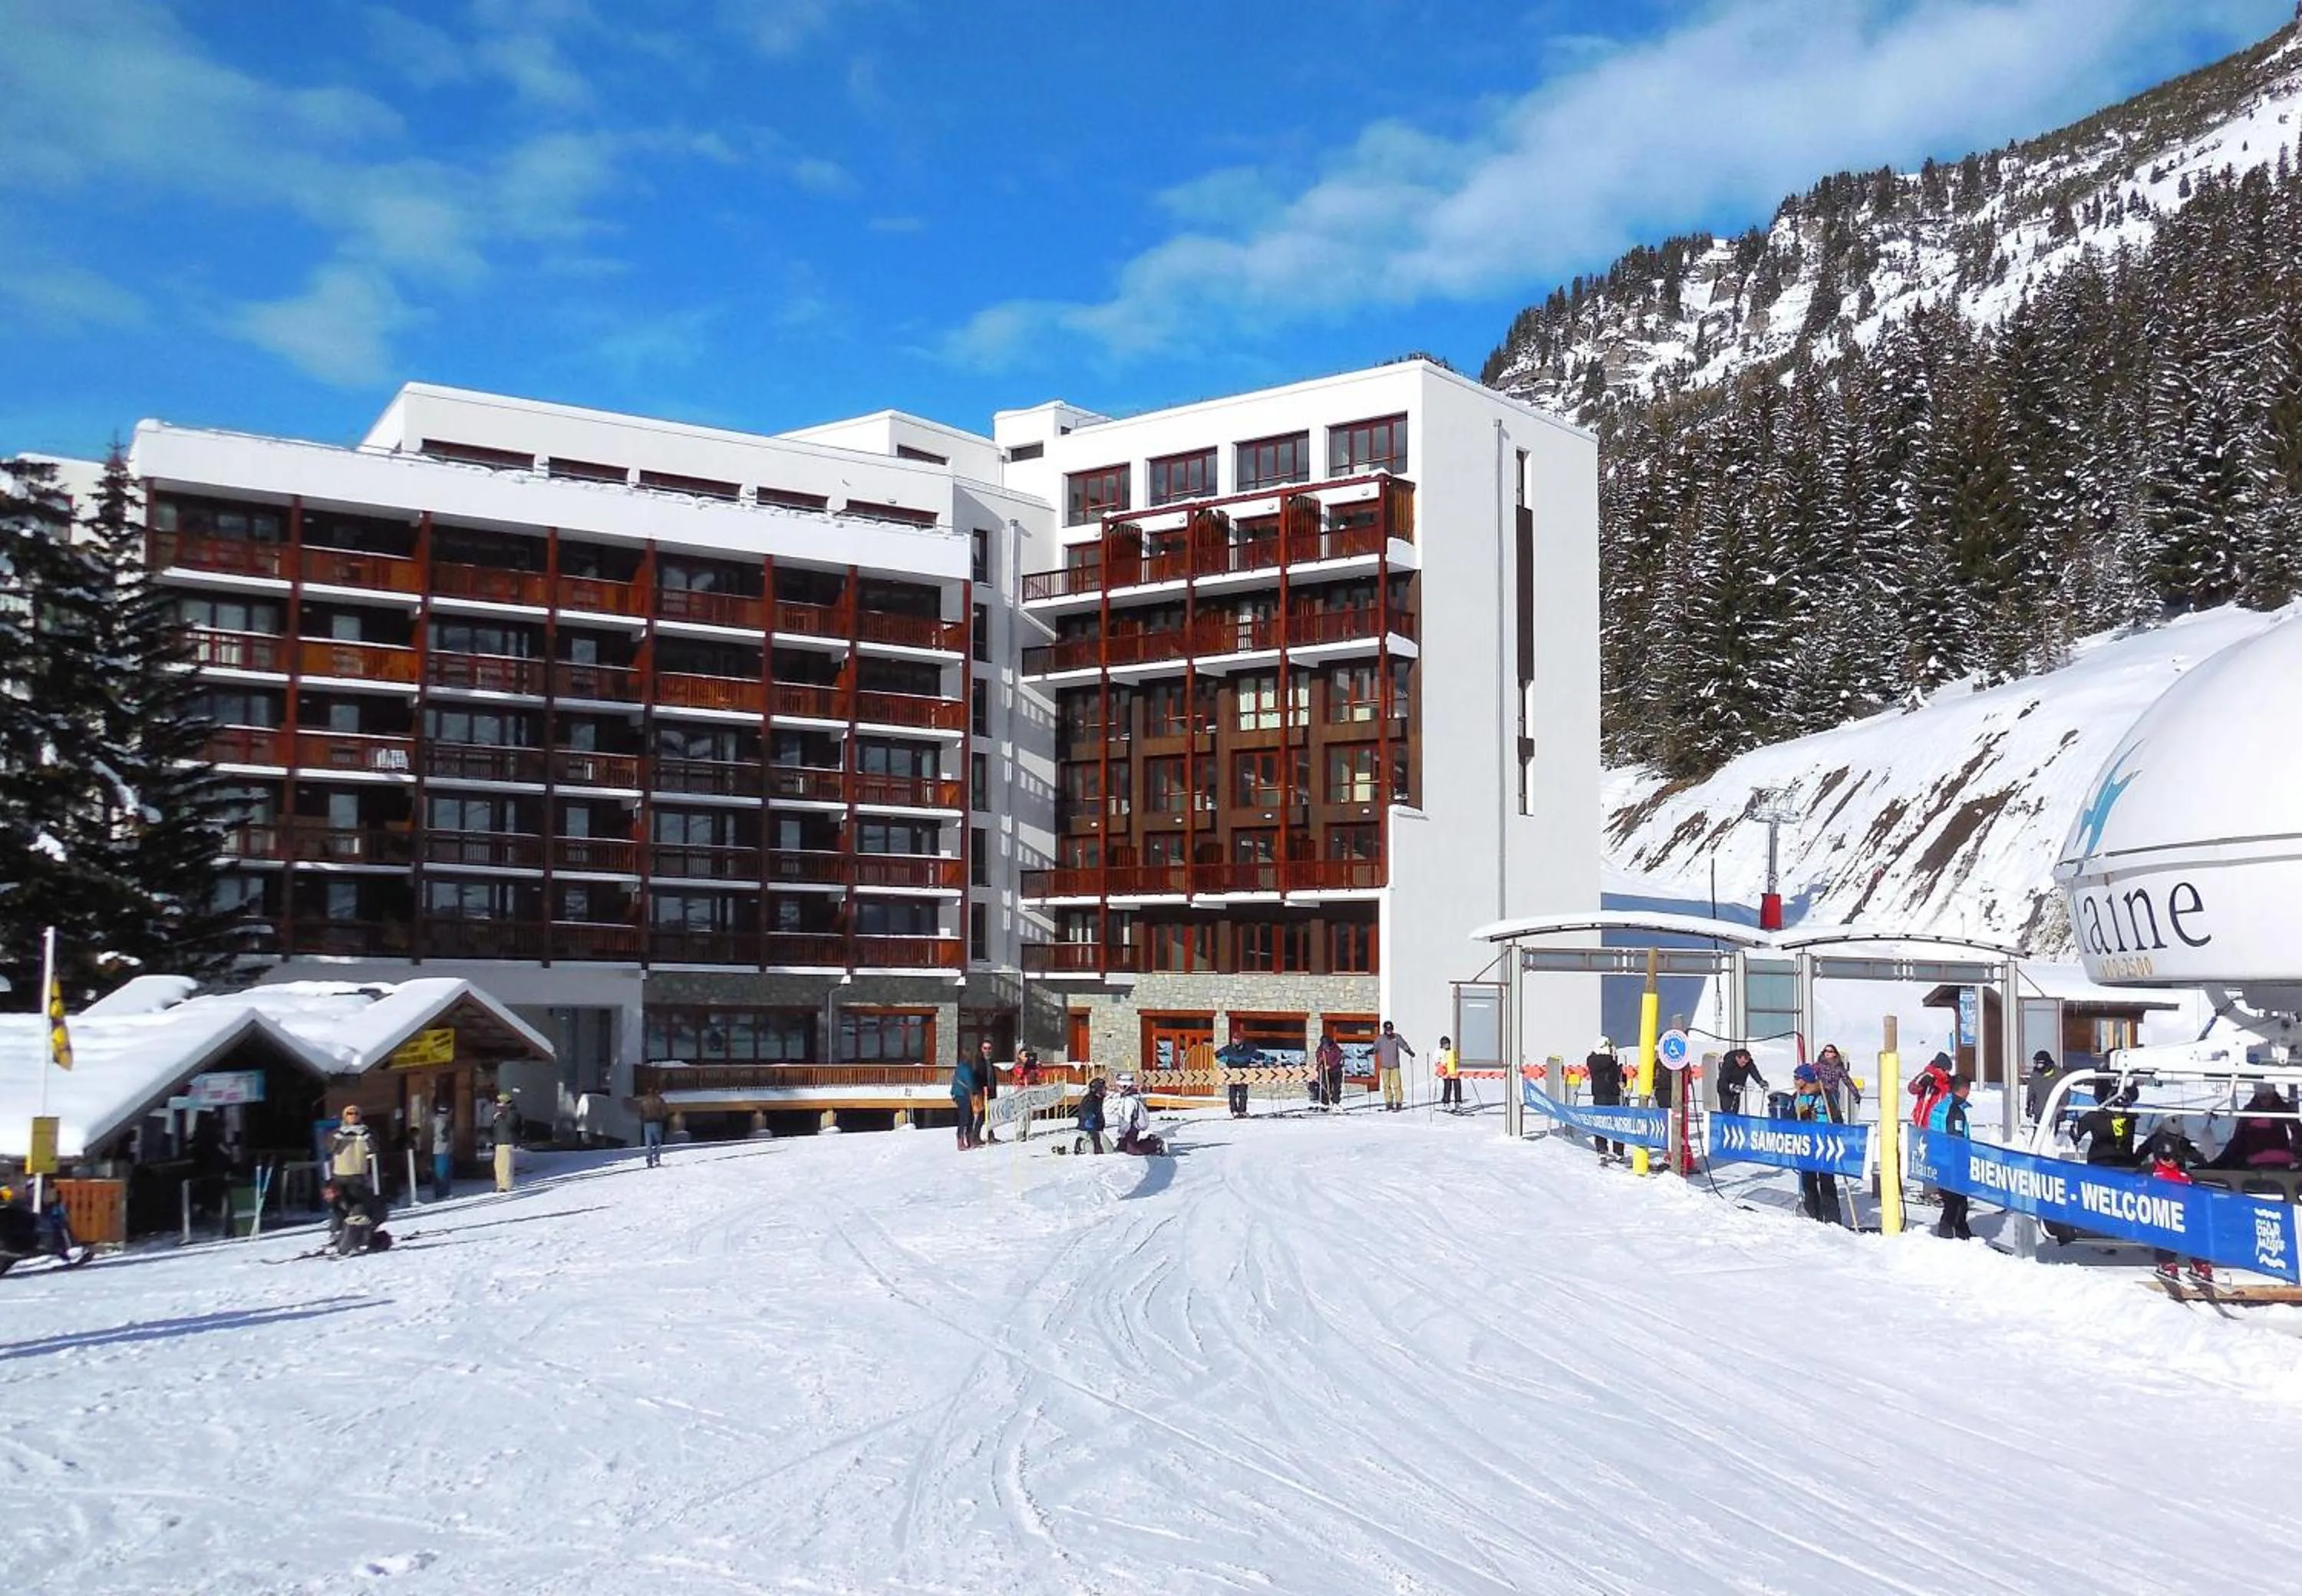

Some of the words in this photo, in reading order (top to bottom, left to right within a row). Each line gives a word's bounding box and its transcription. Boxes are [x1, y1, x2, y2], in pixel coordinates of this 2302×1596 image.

[1750, 1130, 1811, 1156] SAMOENS
[1970, 1156, 2066, 1206] BIENVENUE
[2080, 1181, 2186, 1233] WELCOME
